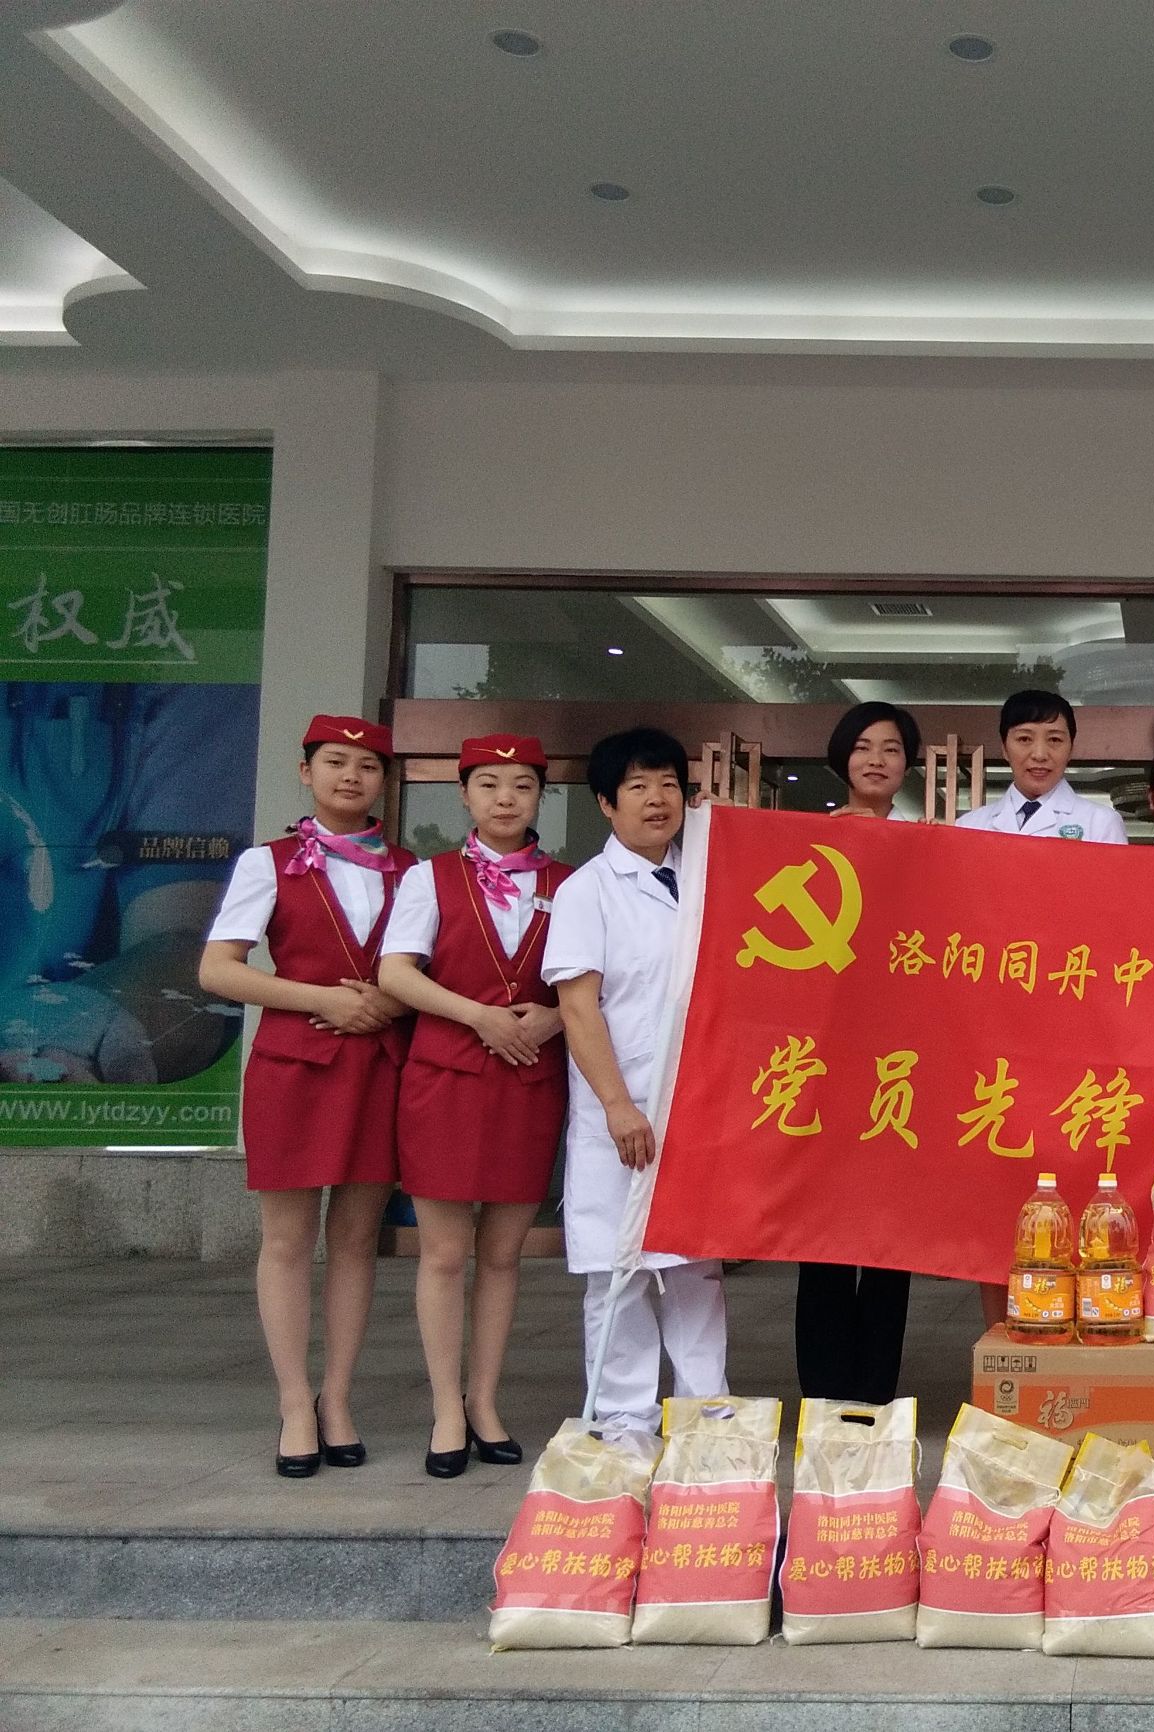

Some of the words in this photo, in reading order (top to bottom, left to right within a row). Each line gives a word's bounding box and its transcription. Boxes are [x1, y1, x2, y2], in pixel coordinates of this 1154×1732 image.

[8, 572, 196, 660] 权威
[139, 836, 230, 859] 品牌信赖
[659, 1502, 740, 1517] 洛阳同丹中医院
[817, 1510, 898, 1529] 洛阳同丹中医院
[816, 1525, 898, 1543] 洛阳市慈善总会
